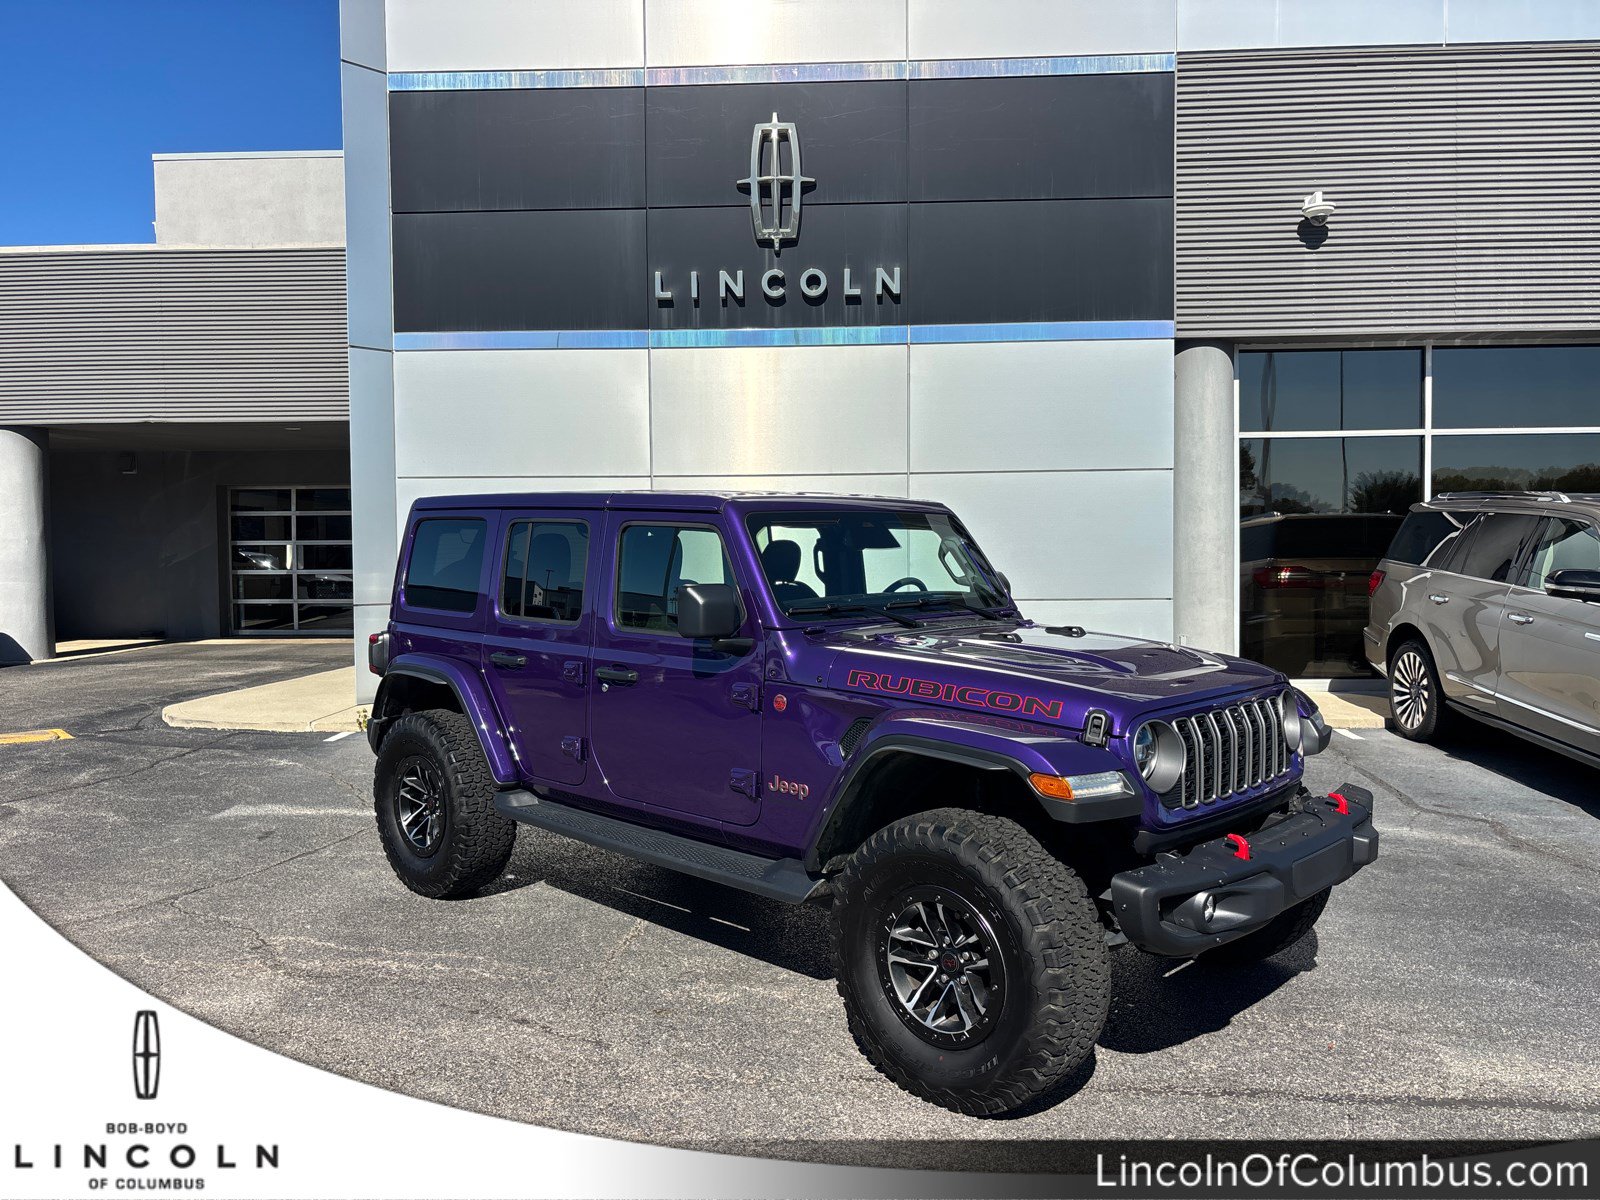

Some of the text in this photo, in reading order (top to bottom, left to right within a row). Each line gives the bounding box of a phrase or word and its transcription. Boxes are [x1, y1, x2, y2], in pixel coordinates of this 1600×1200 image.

[654, 267, 901, 299] LINCOLN
[847, 669, 1063, 719] RUBICON
[768, 774, 809, 800] Jeep
